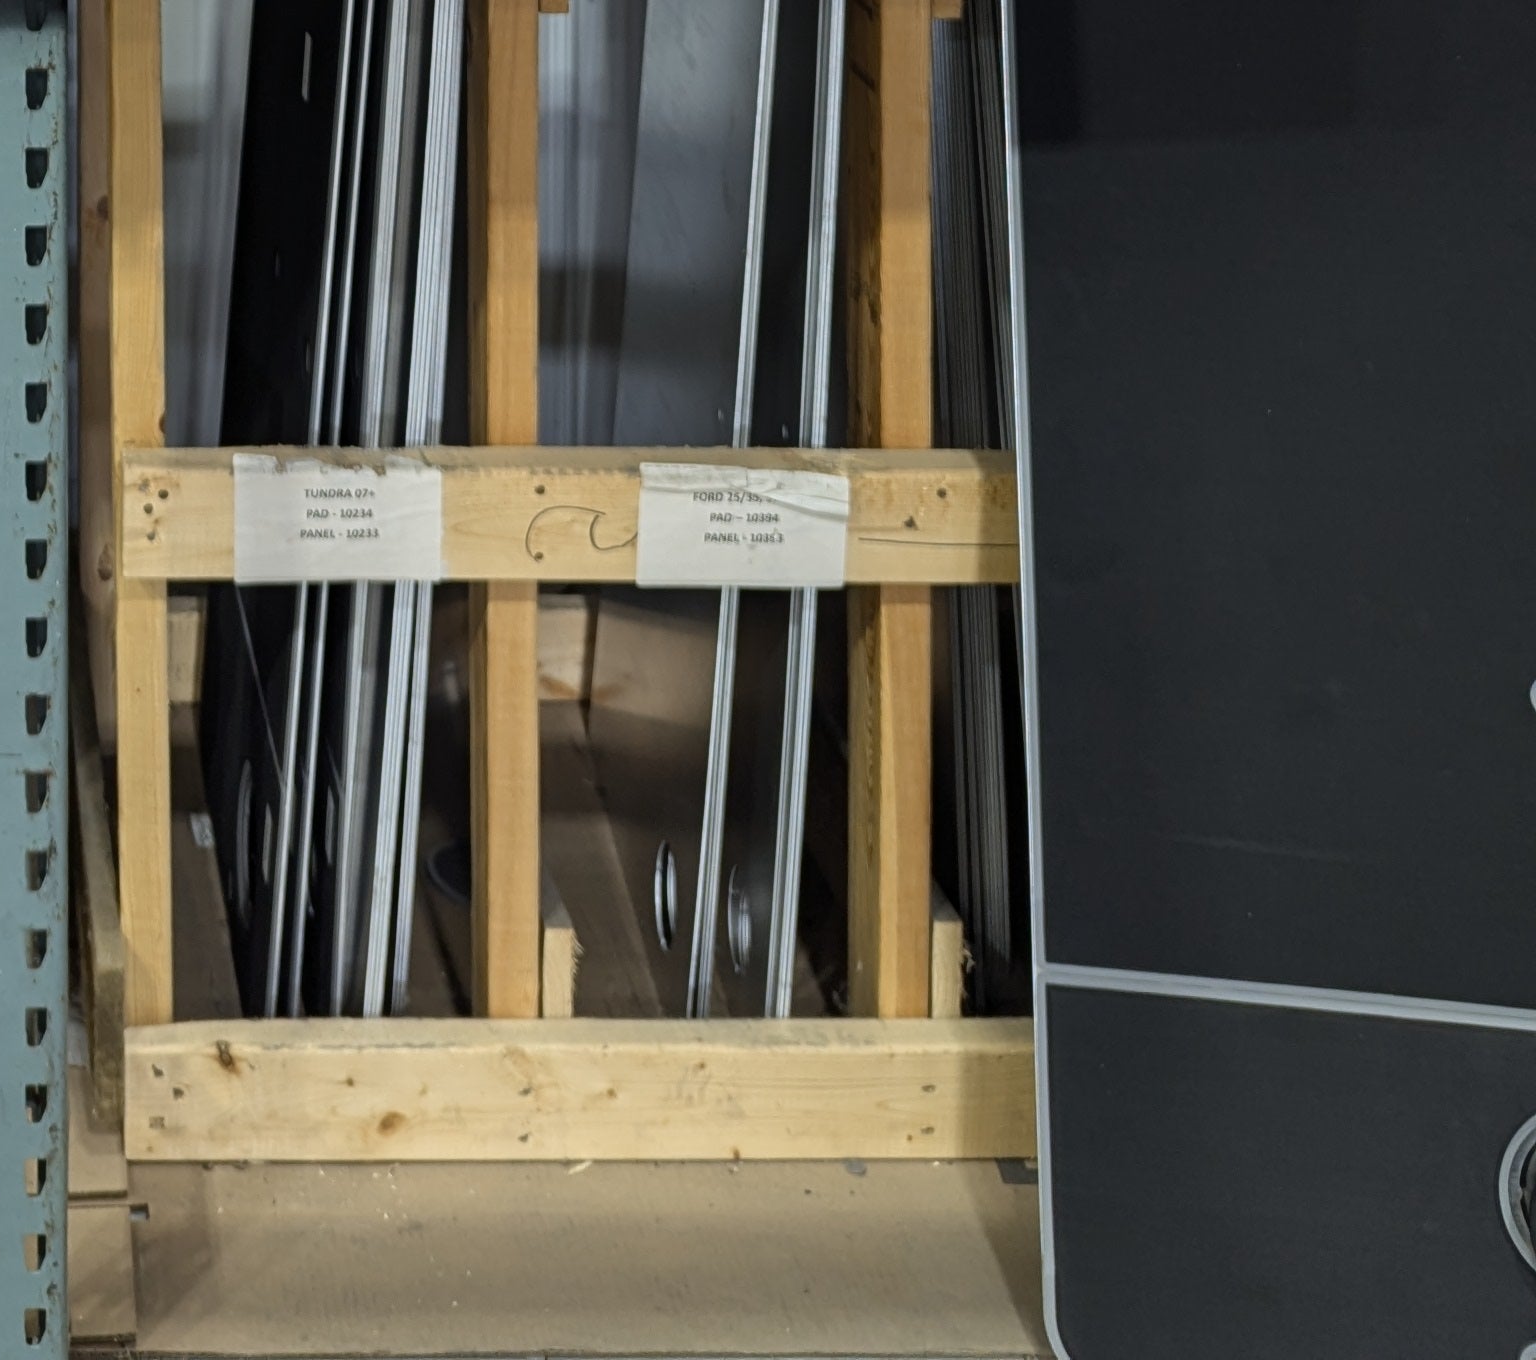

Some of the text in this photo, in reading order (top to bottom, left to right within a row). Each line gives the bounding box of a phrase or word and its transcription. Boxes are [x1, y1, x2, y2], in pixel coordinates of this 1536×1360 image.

[304, 488, 353, 499] TUNDRA
[693, 491, 724, 502] FORD
[306, 509, 329, 519] PAD
[340, 509, 373, 519] 10234
[709, 512, 732, 523] PAD
[300, 529, 336, 539] PANEL
[346, 529, 379, 539] 10233
[704, 533, 740, 544] PANEL
